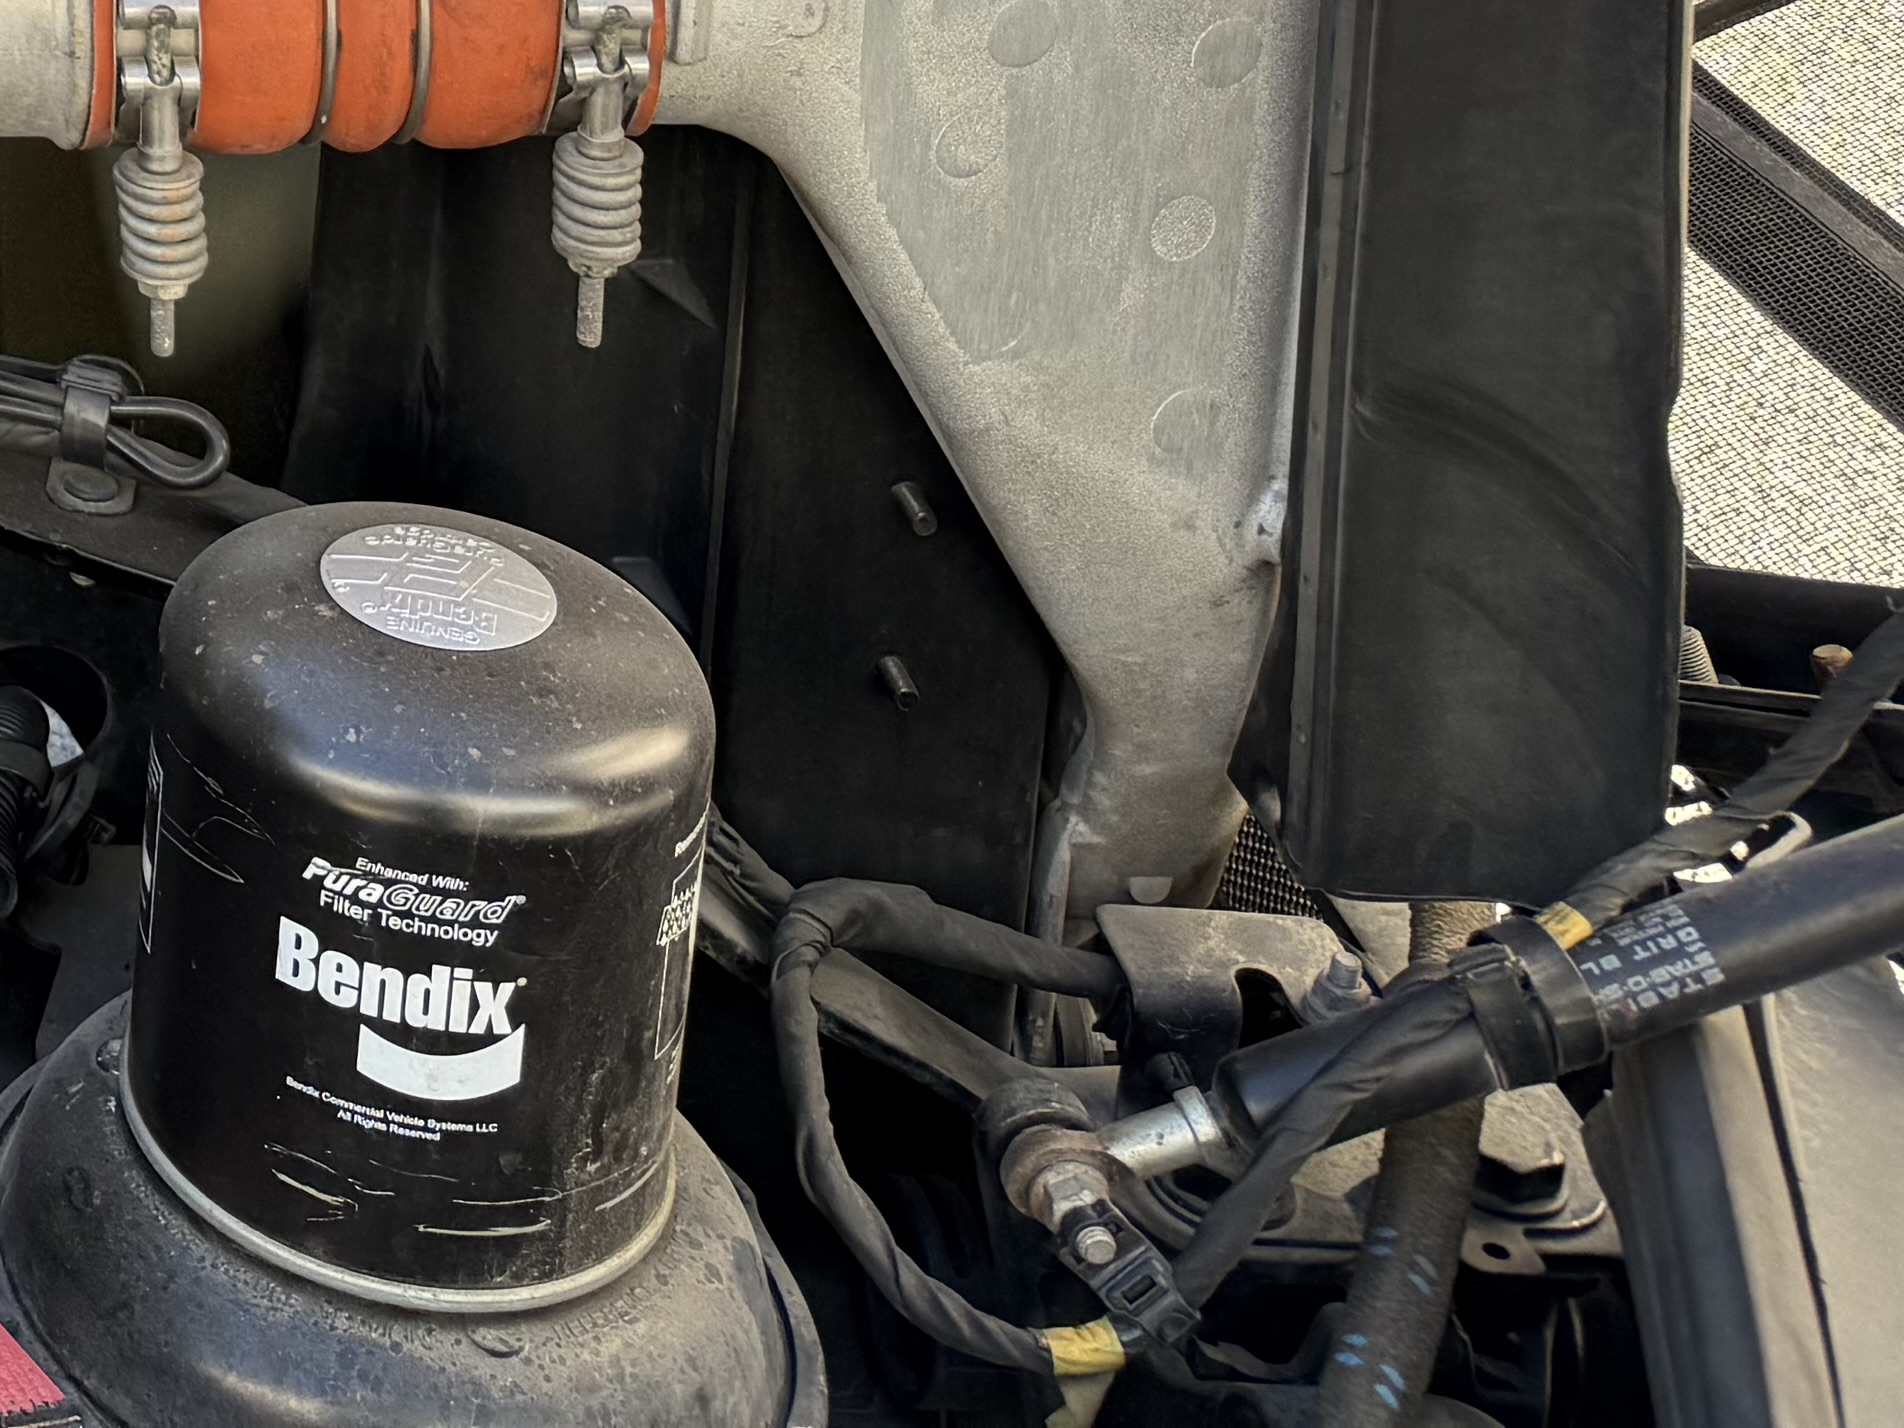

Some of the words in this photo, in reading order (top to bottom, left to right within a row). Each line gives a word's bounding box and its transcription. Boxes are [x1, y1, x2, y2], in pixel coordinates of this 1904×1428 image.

[386, 616, 481, 645] GENUINE
[356, 857, 429, 886] Enhanced
[431, 874, 470, 893] With:
[319, 890, 370, 921] Filter
[379, 909, 499, 946] Technology
[321, 1091, 384, 1118] Commercial
[386, 1110, 425, 1128] Vehicle
[427, 1117, 473, 1134] Systems
[475, 1122, 498, 1133] LLC
[337, 1109, 352, 1120] All
[353, 1113, 387, 1134] Rights
[389, 1124, 441, 1141] Reserved
